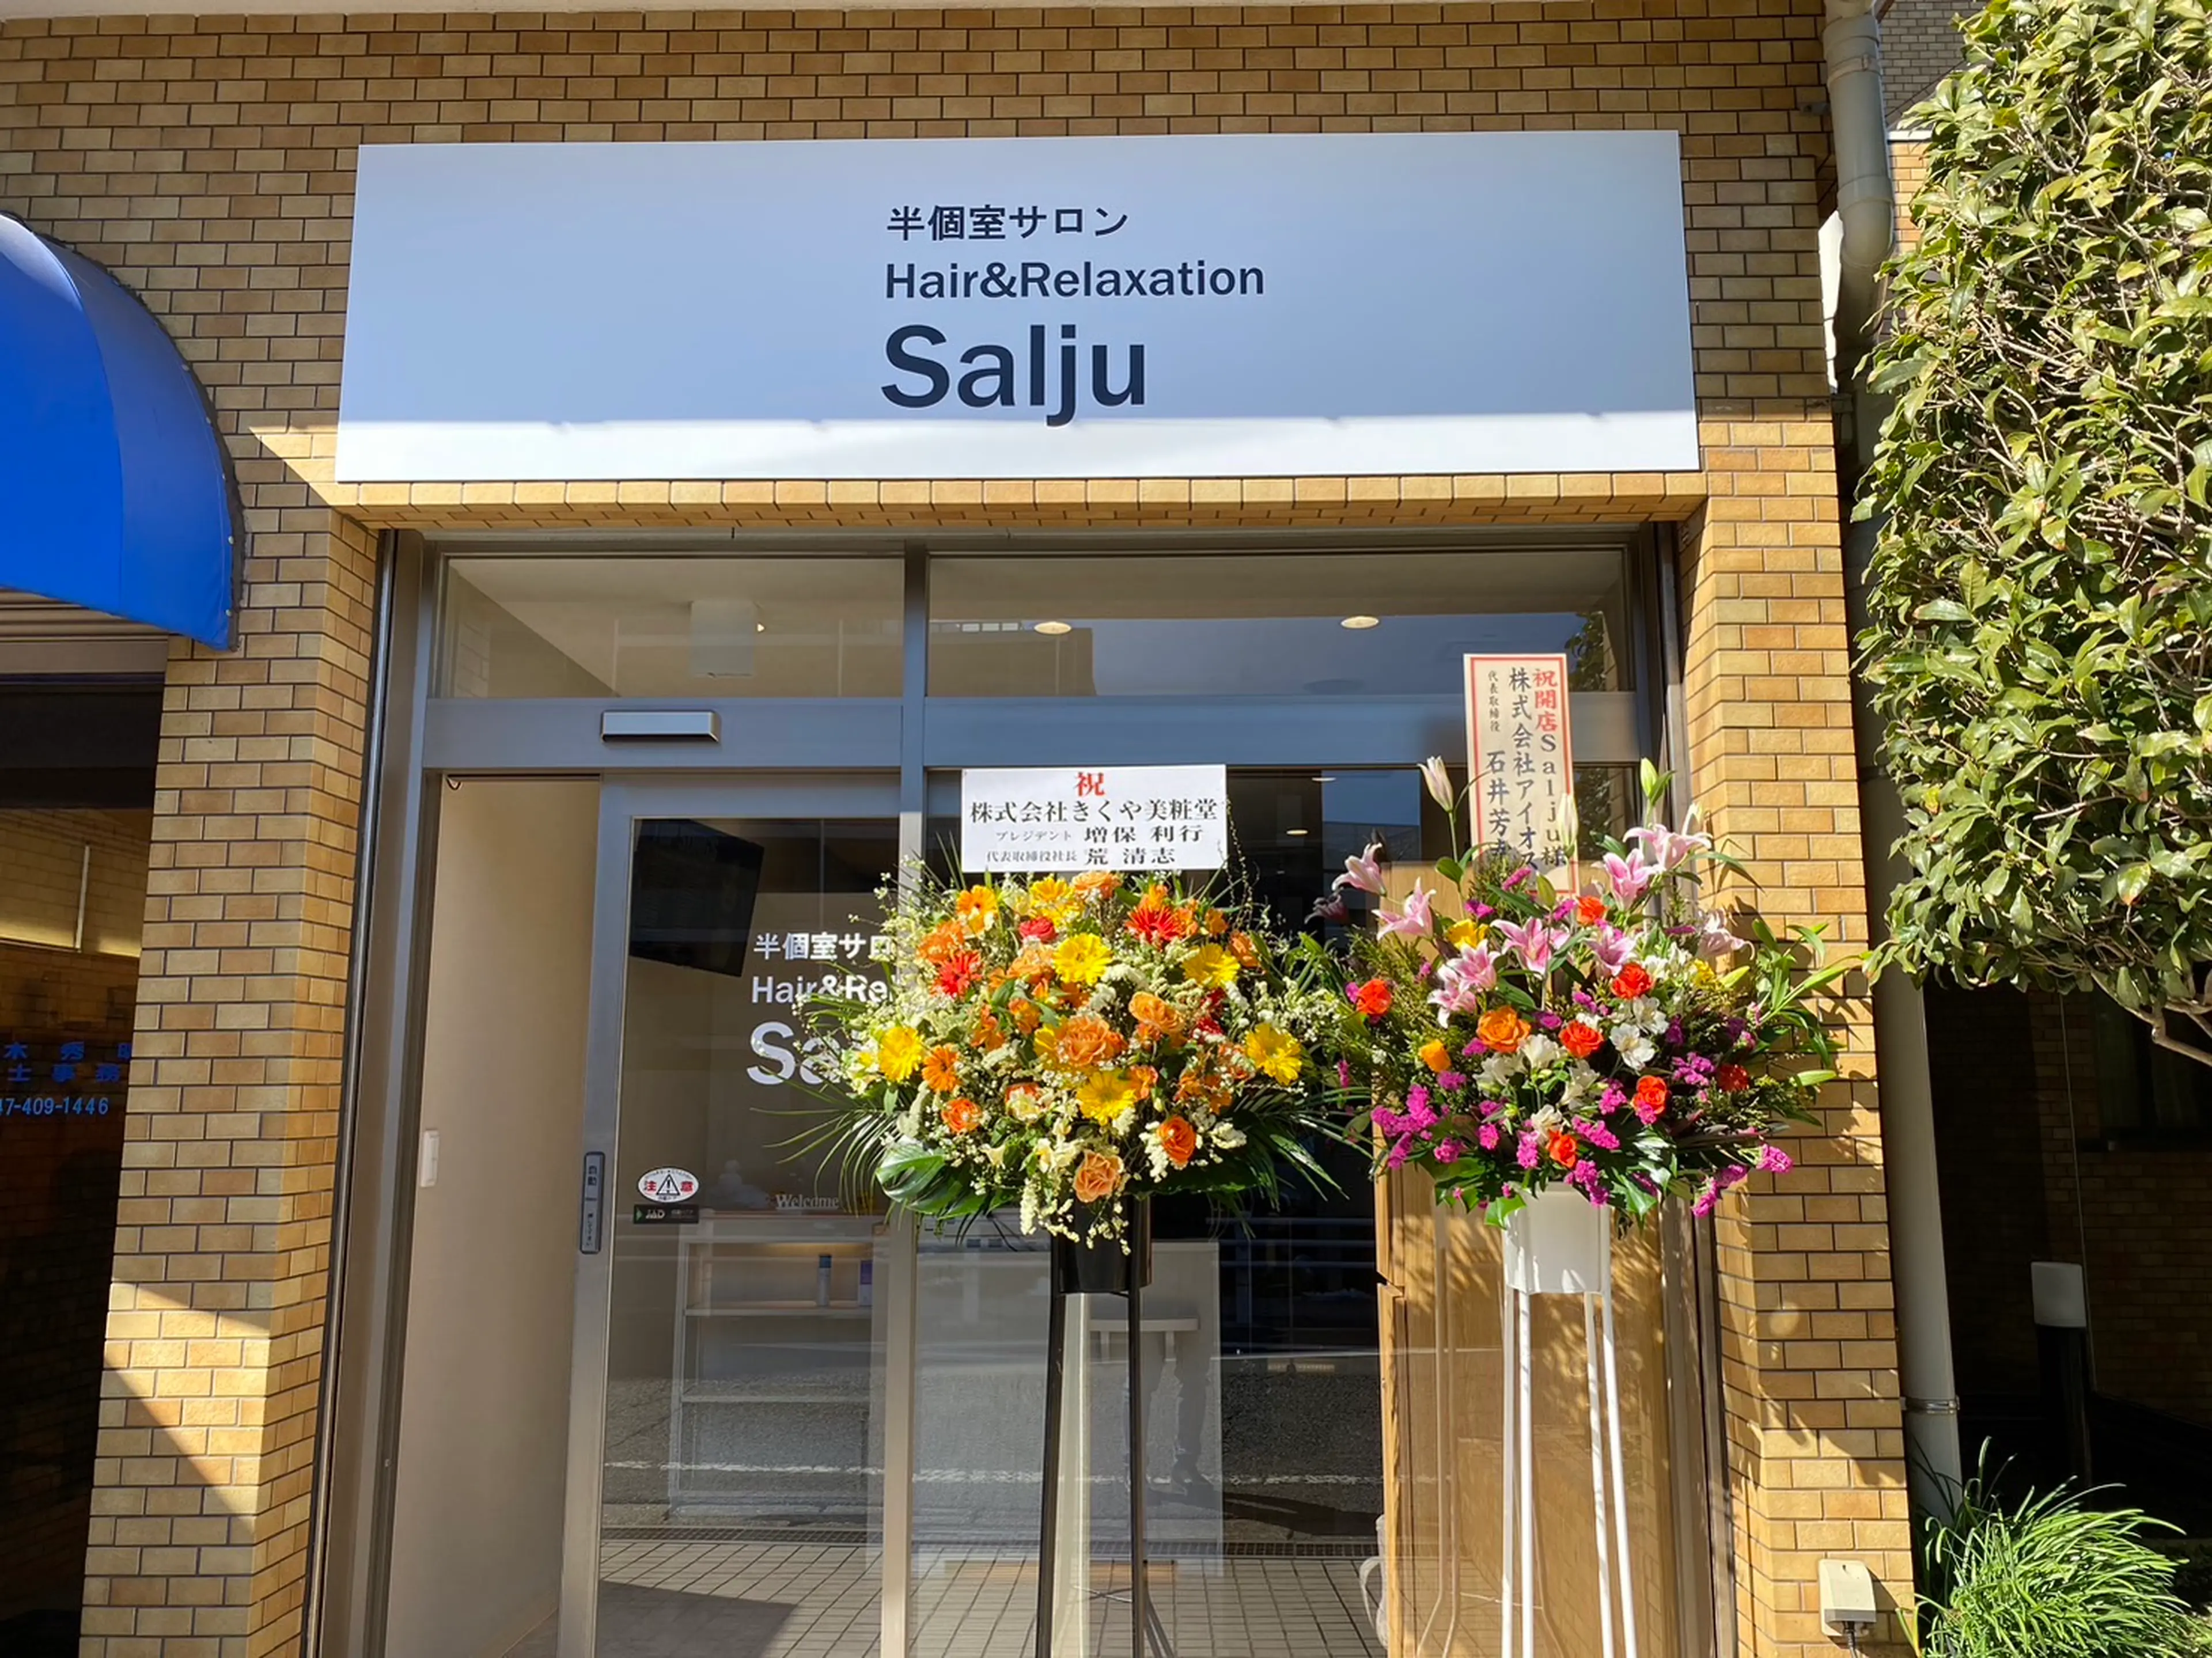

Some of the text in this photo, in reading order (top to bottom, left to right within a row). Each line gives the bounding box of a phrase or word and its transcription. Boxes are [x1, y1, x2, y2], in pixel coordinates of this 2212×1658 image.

[887, 204, 1128, 241] 半個室サロン
[886, 260, 1264, 299] Hair&Relaxation
[881, 324, 1146, 427] Salju
[1487, 669, 1500, 733] 代表取締役
[1075, 771, 1105, 798] 祝
[1509, 667, 1539, 870] 株式会社アイオス
[970, 798, 1218, 824] 株式会社きくや美粧堂
[995, 824, 1203, 844] プレジデント 増保 利行
[986, 850, 1078, 863] 代表取締役社長
